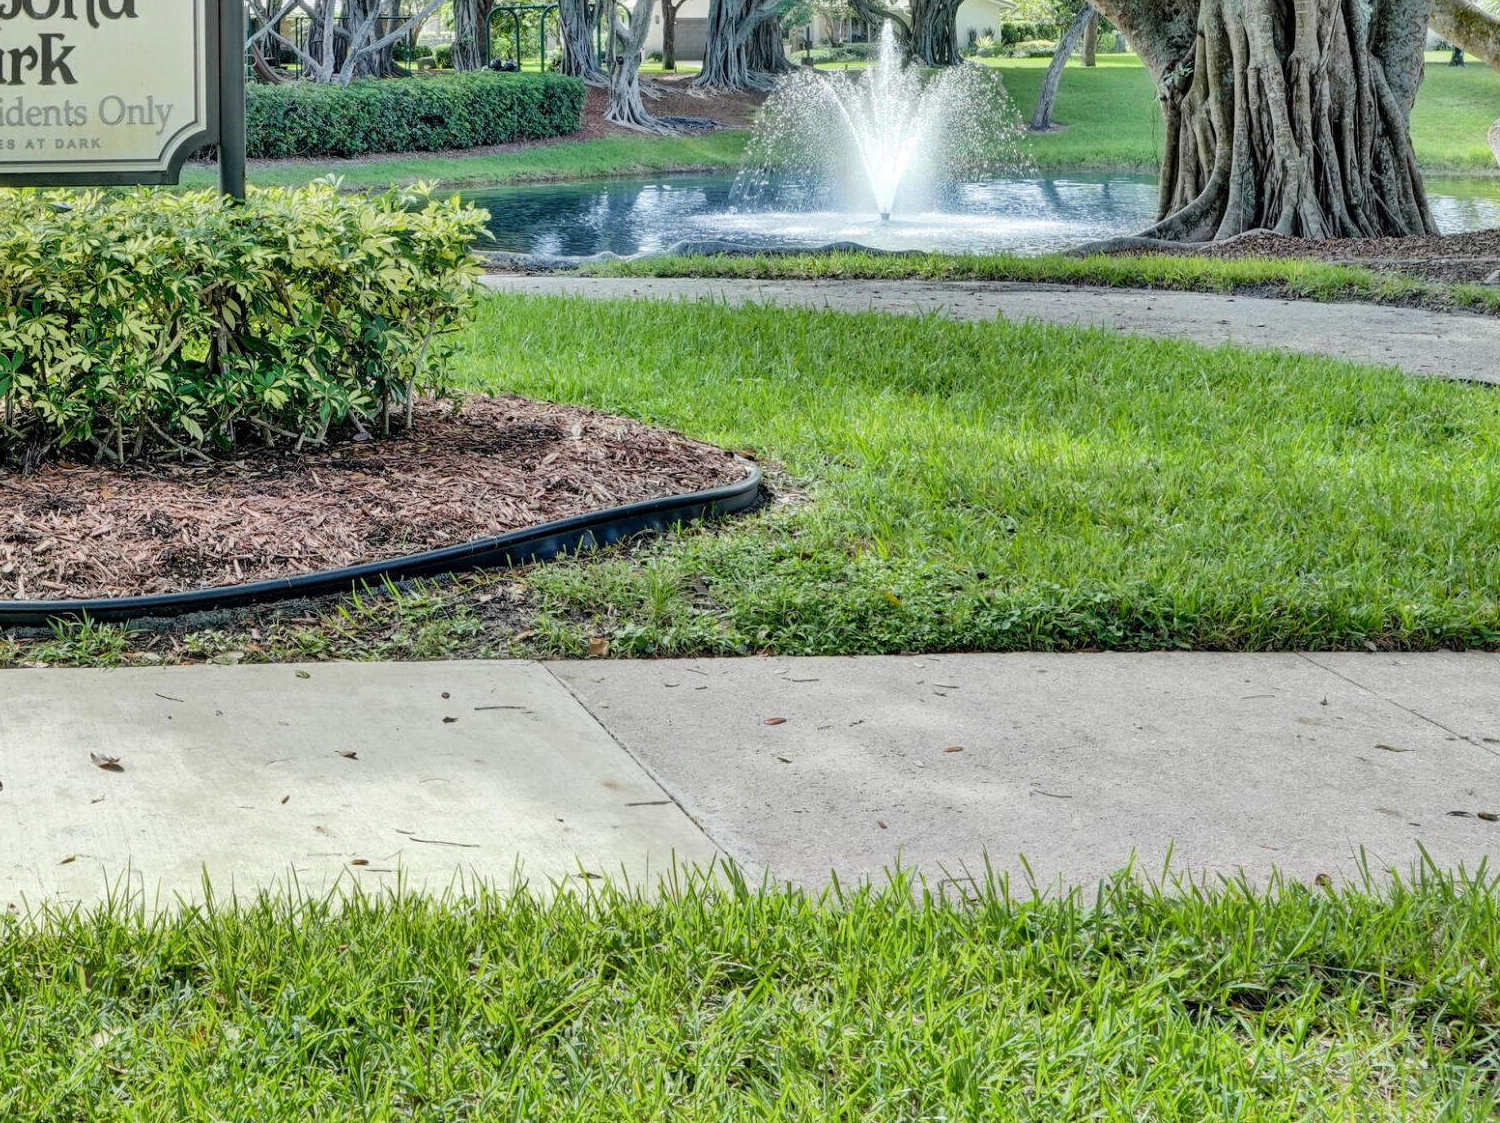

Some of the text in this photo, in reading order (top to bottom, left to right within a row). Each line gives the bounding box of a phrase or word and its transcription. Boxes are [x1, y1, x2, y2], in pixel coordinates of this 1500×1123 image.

[98, 95, 174, 136] Only
[25, 138, 46, 150] AT
[54, 137, 101, 150] DARK
